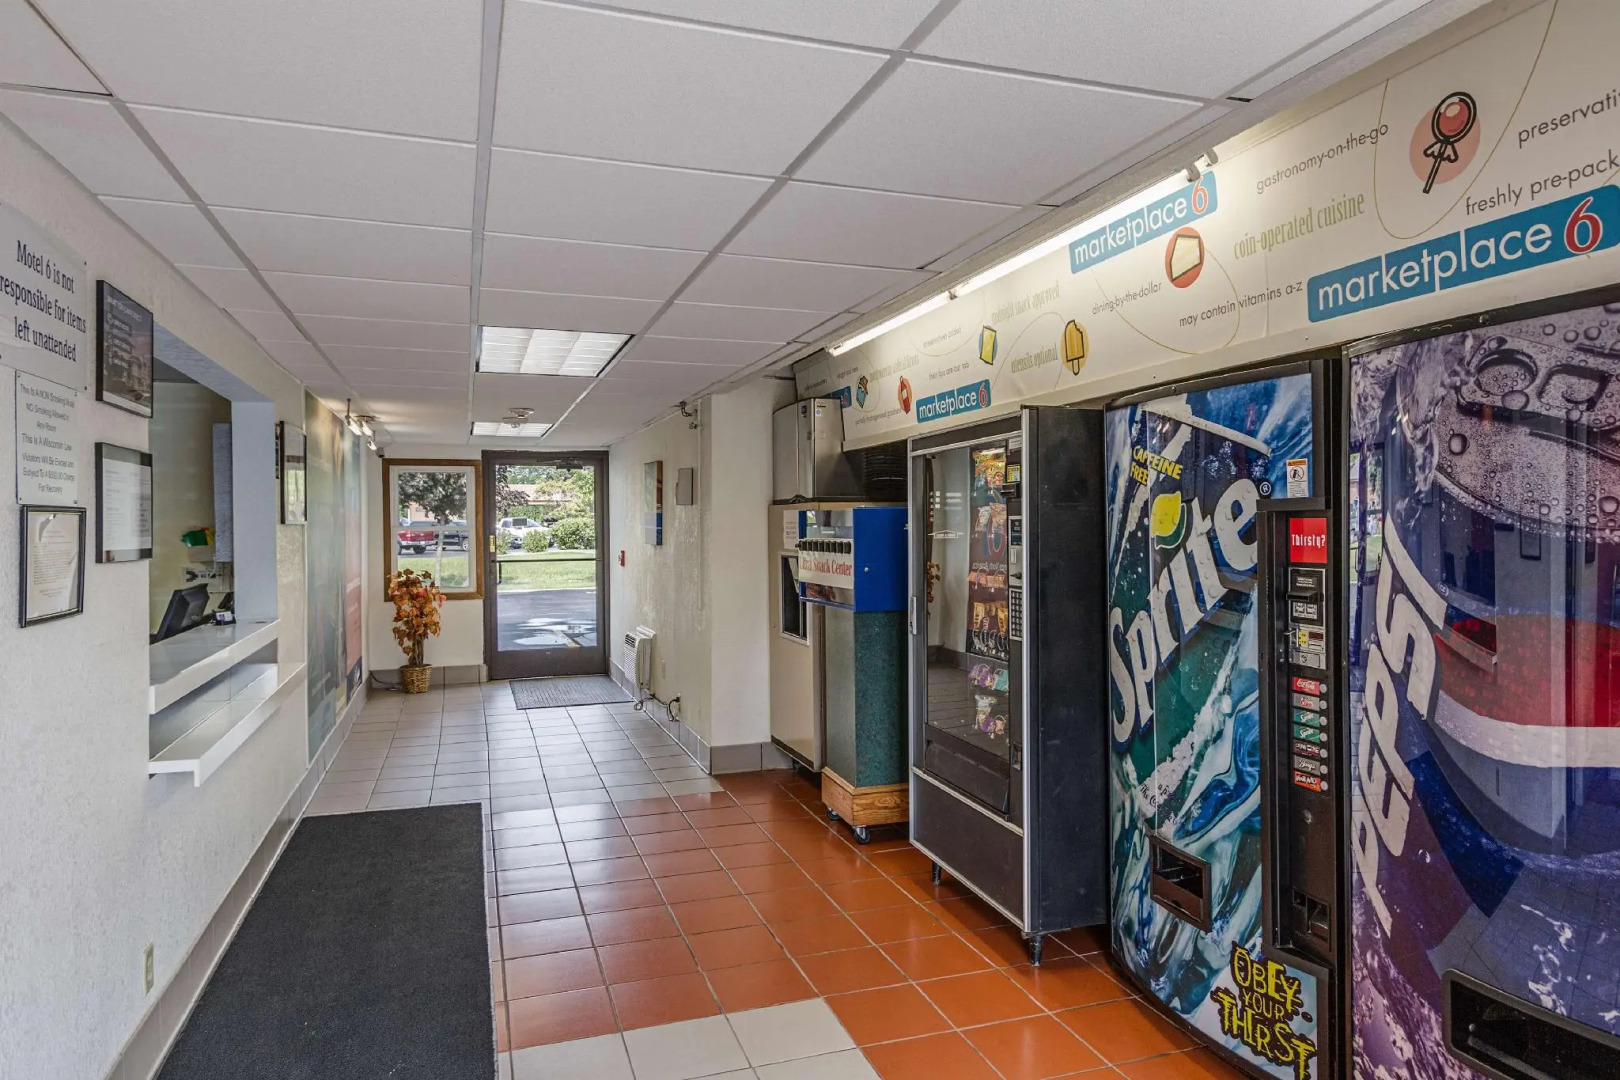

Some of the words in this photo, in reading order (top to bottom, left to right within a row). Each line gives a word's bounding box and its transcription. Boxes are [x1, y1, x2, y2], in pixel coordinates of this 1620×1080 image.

[1518, 88, 1620, 150] preservati
[1256, 122, 1389, 195] gastronomy-on-the-go
[1075, 197, 1188, 265] marketplace
[1192, 174, 1209, 216] 6
[1465, 182, 1523, 217] freshly
[1233, 207, 1314, 261] coin-operated
[1316, 191, 1365, 228] cuisine
[16, 240, 44, 276] Motel
[45, 258, 52, 280] 6
[53, 262, 61, 286] is
[61, 274, 75, 294] not
[1317, 222, 1553, 311] marketplace
[1563, 196, 1604, 255] 6
[0, 275, 53, 317] responsible
[54, 299, 66, 322] for
[66, 306, 87, 334] items
[1091, 281, 1163, 315] dining-by-the-dollar
[1179, 312, 1199, 328] may
[1200, 300, 1236, 321] contain
[1238, 287, 1282, 309] vitamins
[1285, 280, 1304, 296] a-z
[14, 316, 30, 344] left
[32, 327, 77, 363] unattended
[1033, 343, 1059, 369] optional
[919, 390, 977, 419] marketplace
[978, 380, 988, 408] 6
[1130, 461, 1149, 486] FREE
[1132, 445, 1184, 481] CAFFEINE
[1291, 534, 1326, 549] Thirsty?
[813, 558, 831, 575] Snack
[831, 559, 853, 577] Center
[1109, 478, 1258, 743] Sprite
[1351, 511, 1448, 939] PEPSI
[1233, 946, 1299, 1014] OBEY
[1242, 987, 1285, 1021] YOUR
[1216, 990, 1316, 1080] THIRST
